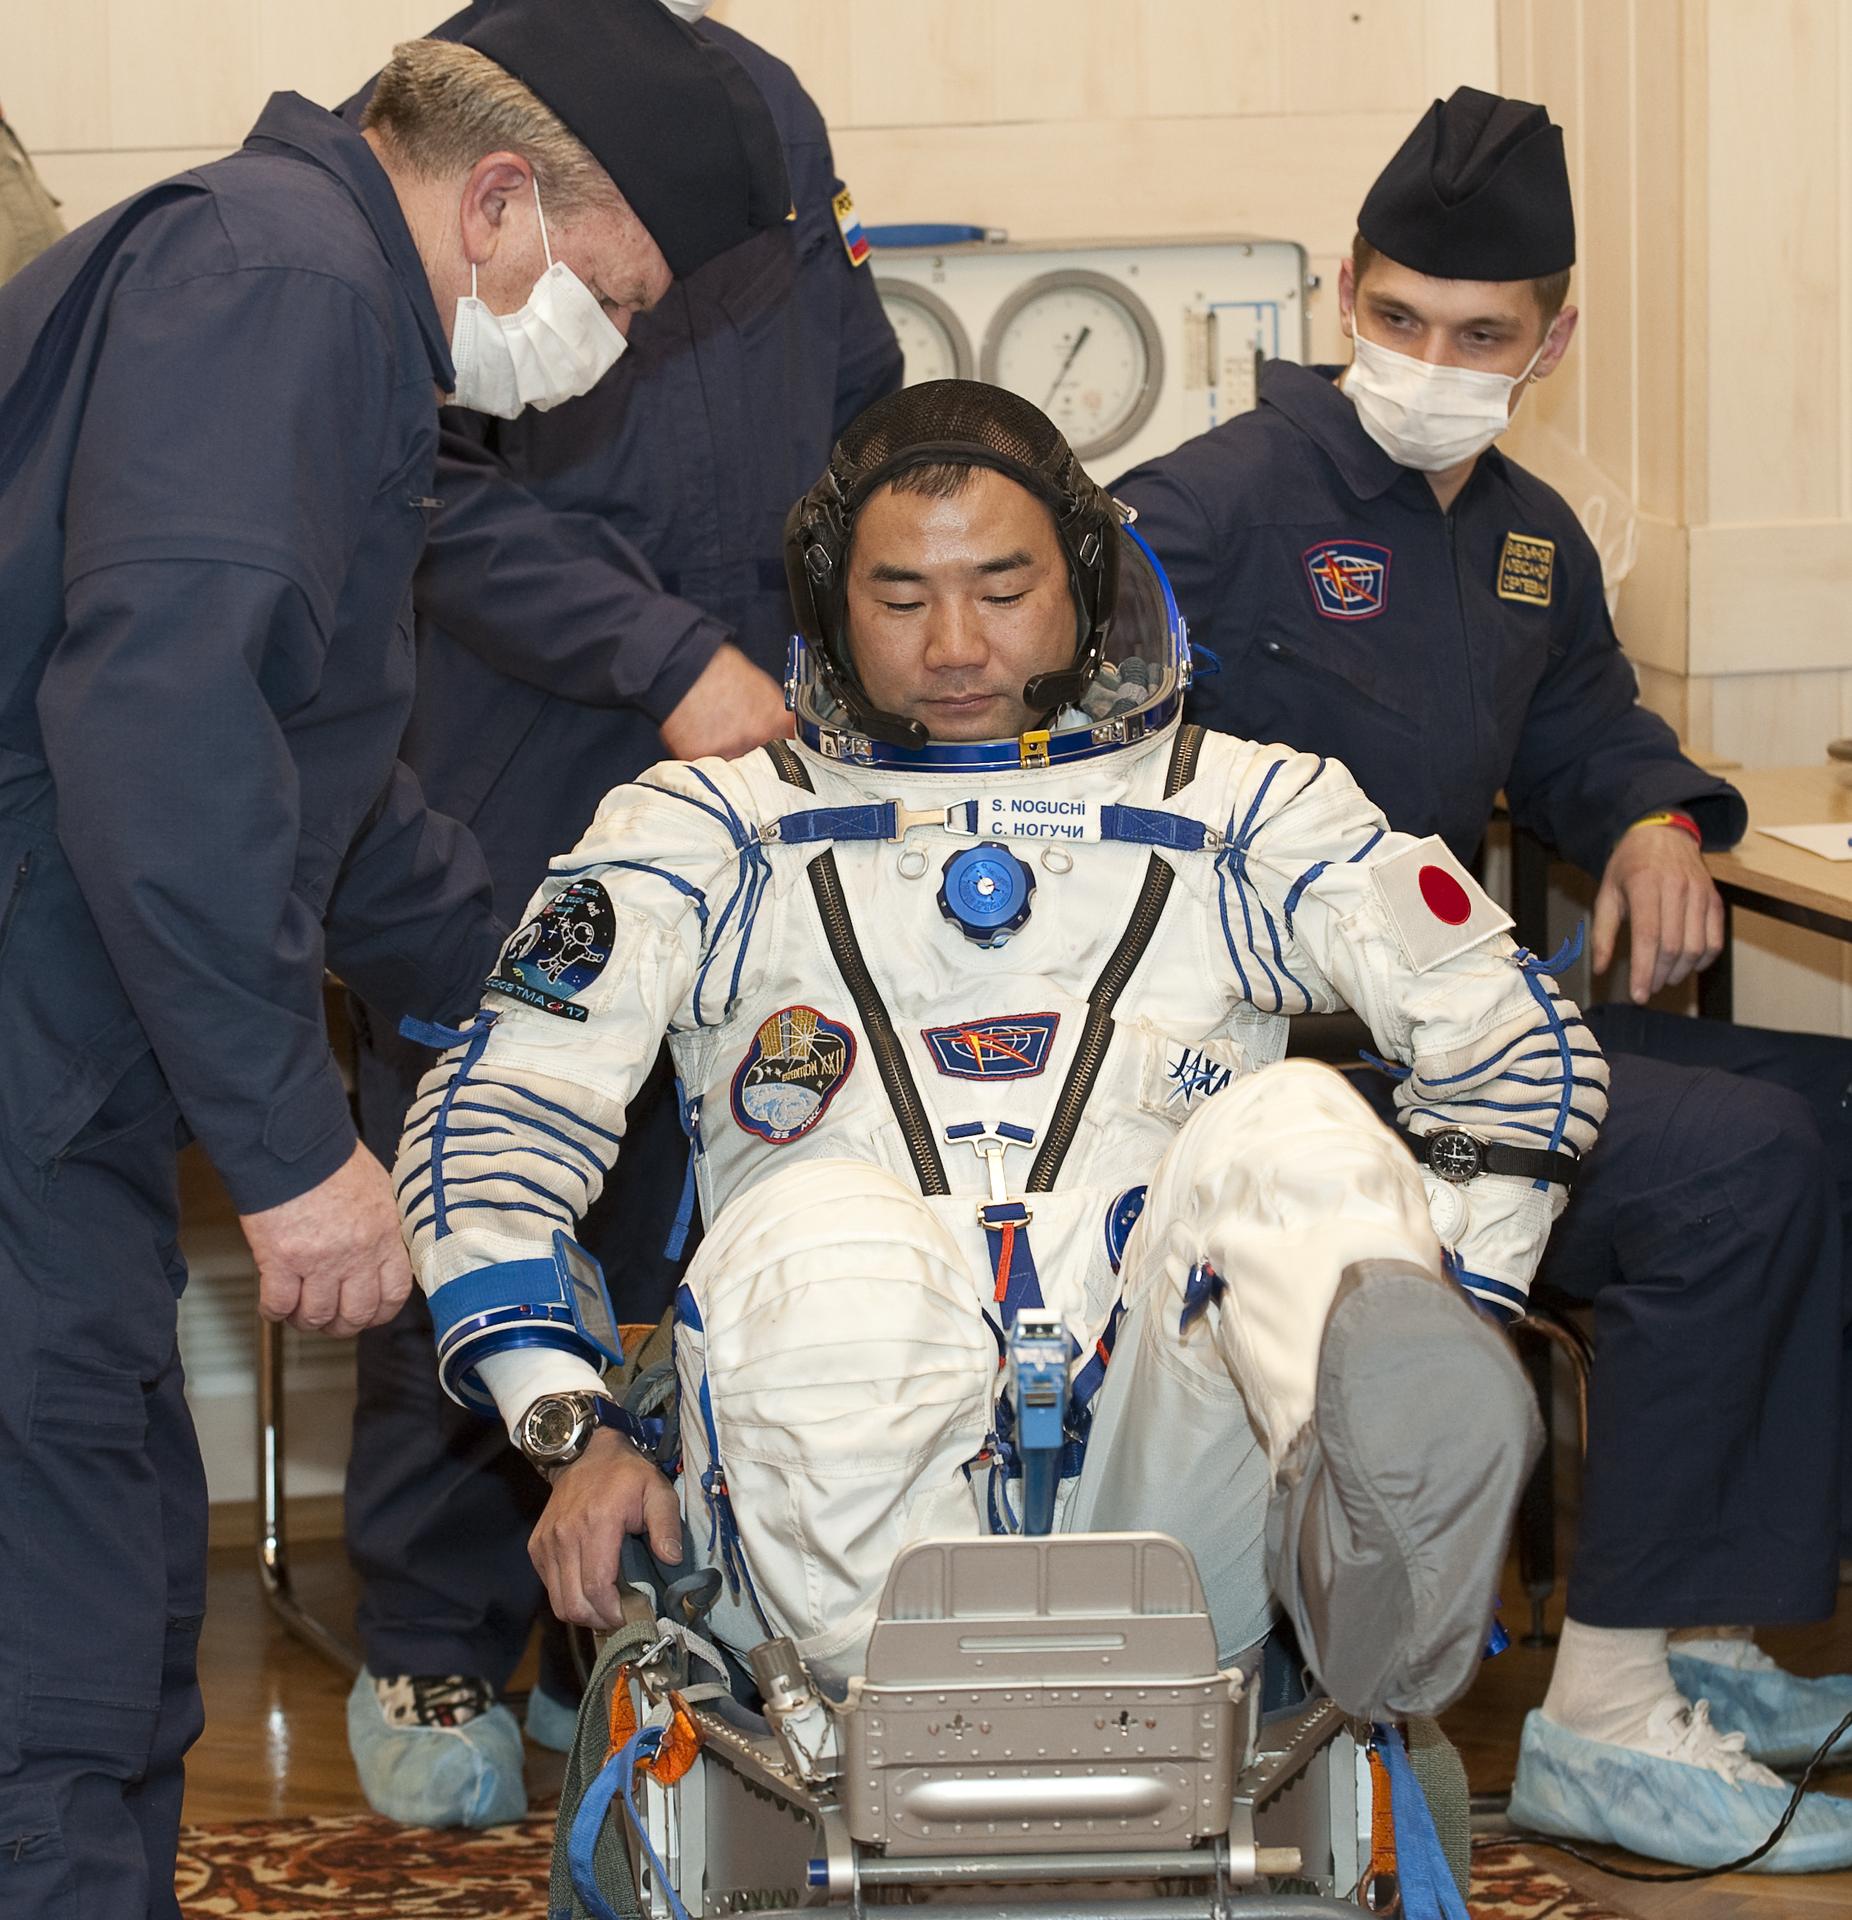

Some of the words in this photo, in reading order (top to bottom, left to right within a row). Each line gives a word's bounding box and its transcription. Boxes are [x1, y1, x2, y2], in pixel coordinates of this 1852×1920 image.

[991, 799, 1006, 812] S.
[991, 821, 1007, 835] С.
[1014, 822, 1084, 838] НОГУЧИ
[566, 1006, 585, 1018] 17
[770, 1129, 790, 1139] ISS
